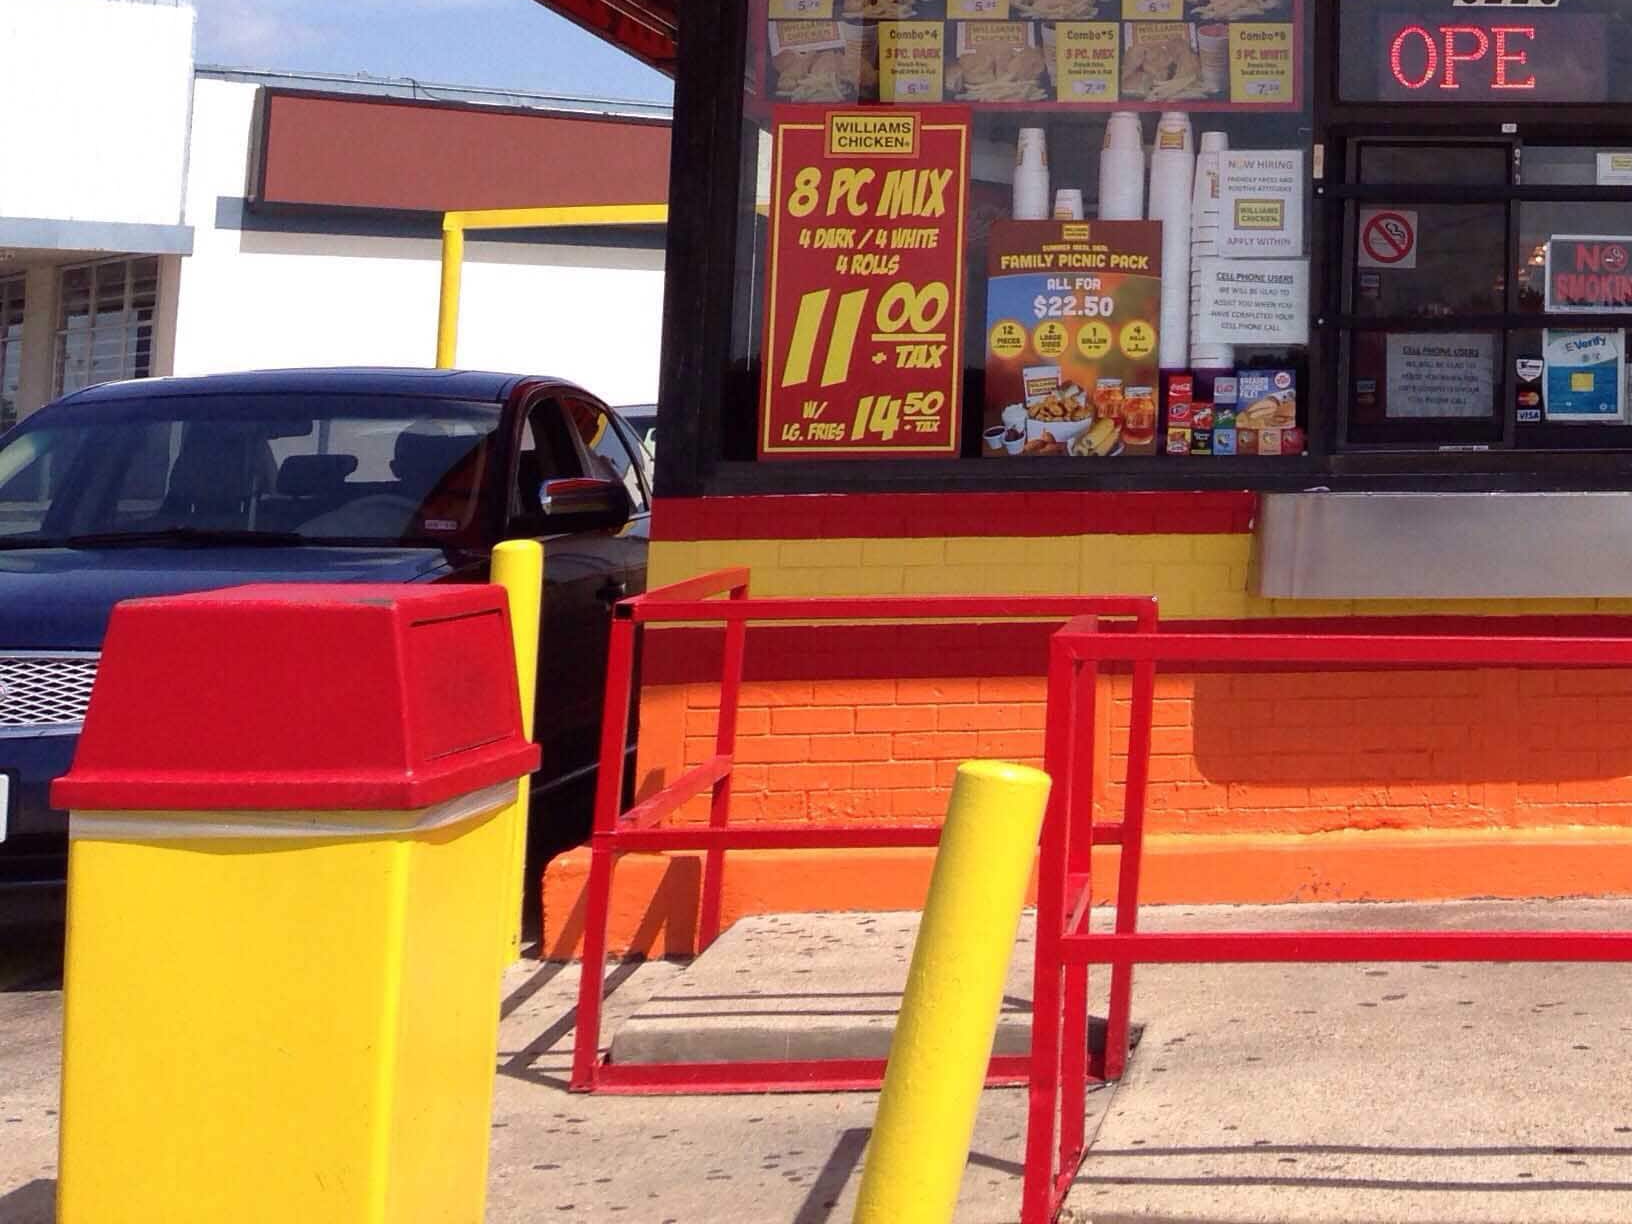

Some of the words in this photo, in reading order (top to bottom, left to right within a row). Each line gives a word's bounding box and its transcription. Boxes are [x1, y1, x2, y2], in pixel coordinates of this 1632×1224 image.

[1390, 24, 1536, 89] OPE
[834, 122, 911, 134] WILLIAMS
[1256, 160, 1294, 170] HIRING
[788, 167, 822, 217] 8
[826, 167, 876, 217] PC
[875, 168, 953, 219] MIX
[799, 228, 811, 249] 4
[813, 228, 855, 249] DARK
[875, 228, 887, 249] 4
[891, 228, 940, 249] WHITE
[1227, 237, 1255, 247] APPLY
[835, 254, 849, 275] 4
[850, 253, 900, 275] ROLLS
[1001, 254, 1053, 270] FAMILY
[1058, 254, 1107, 269] PICNIC
[1110, 254, 1149, 270] PACK
[1047, 278, 1072, 291] ALL
[1075, 278, 1102, 290] FOR
[1236, 272, 1265, 282] PHONE
[1033, 295, 1114, 319] $22.50
[1002, 325, 1014, 336] 12
[1047, 324, 1056, 334] 2
[896, 344, 948, 369] TAX
[781, 423, 804, 441] LG.
[807, 423, 845, 441] FRIES
[851, 395, 902, 441] 14
[903, 390, 945, 415] 50
[802, 400, 828, 419] W/
[1519, 411, 1540, 420] VISA
